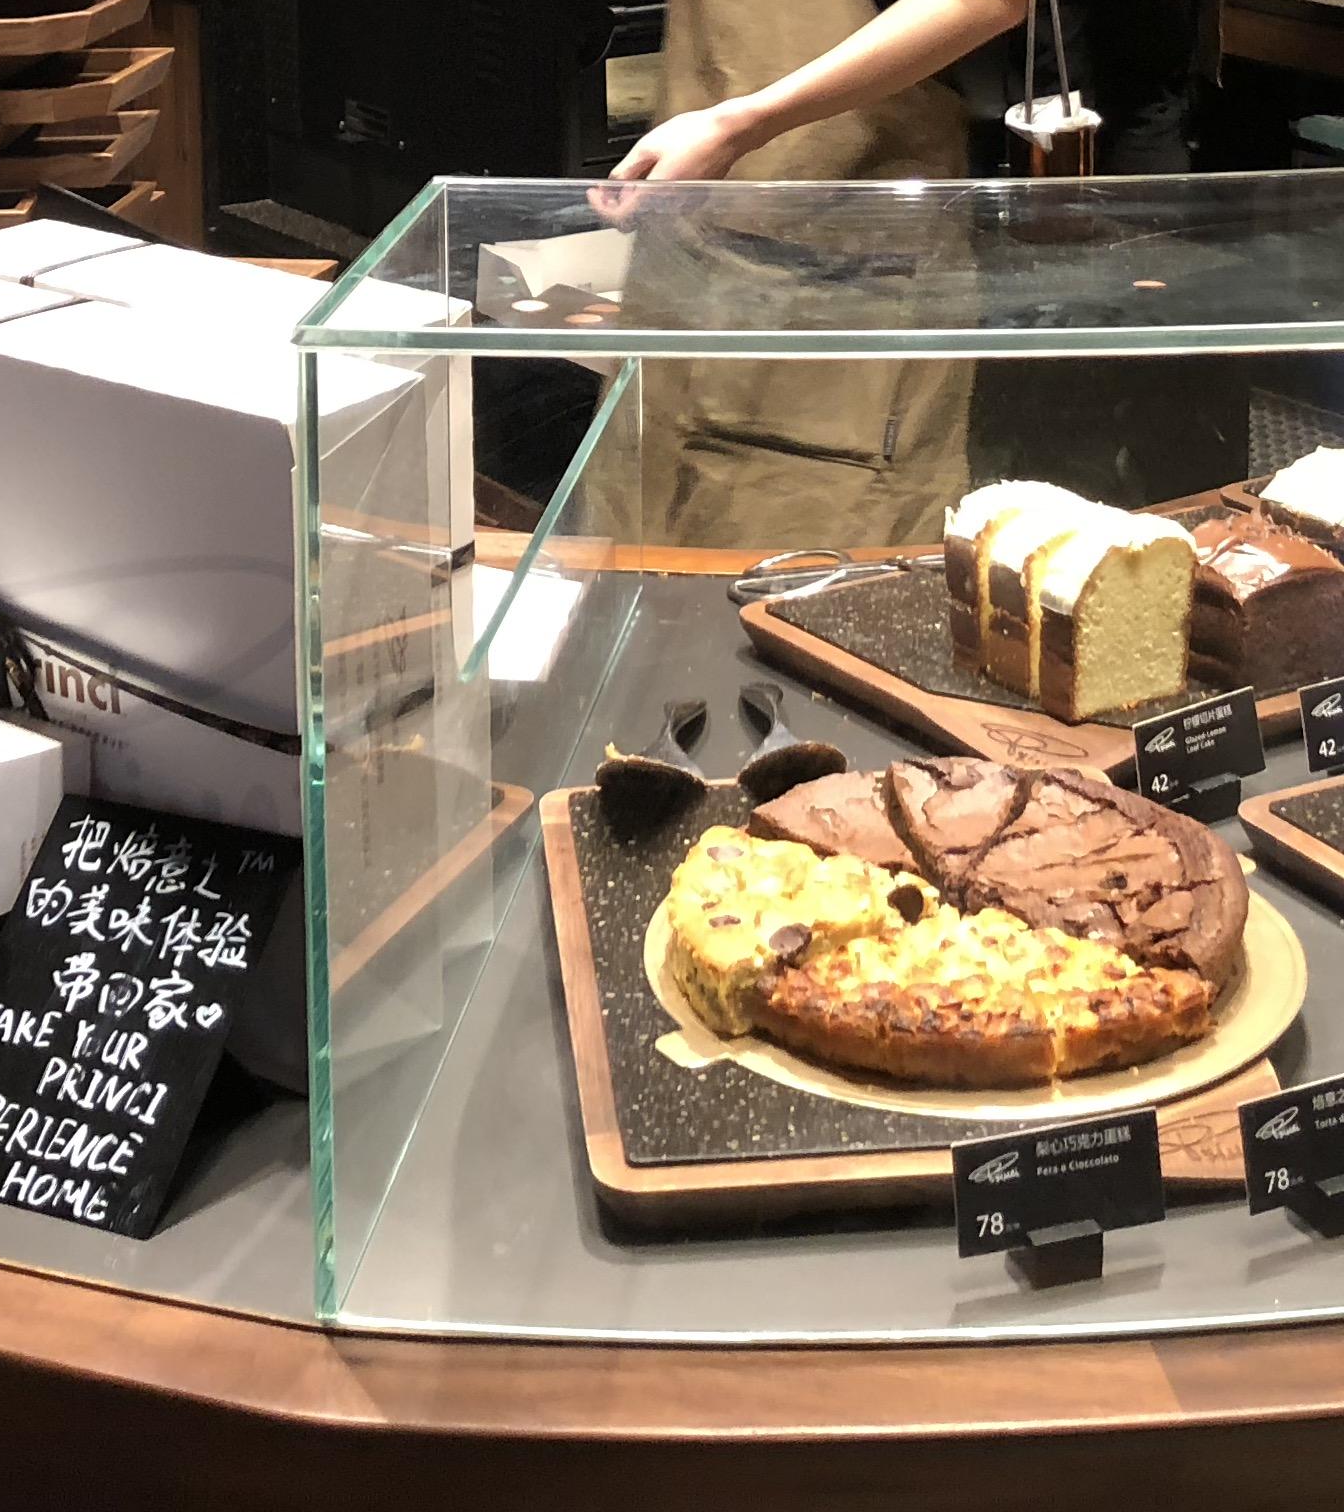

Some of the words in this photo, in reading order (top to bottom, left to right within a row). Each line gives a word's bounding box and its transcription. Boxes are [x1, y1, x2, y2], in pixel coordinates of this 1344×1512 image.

[1319, 738, 1337, 758] 42
[1151, 773, 1170, 794] 42
[25, 876, 253, 970] 的美味体验
[53, 950, 197, 1031] 带回家
[37, 1056, 168, 1126] PRINCI
[1264, 1167, 1290, 1194] 78
[976, 1211, 1005, 1238] 78
